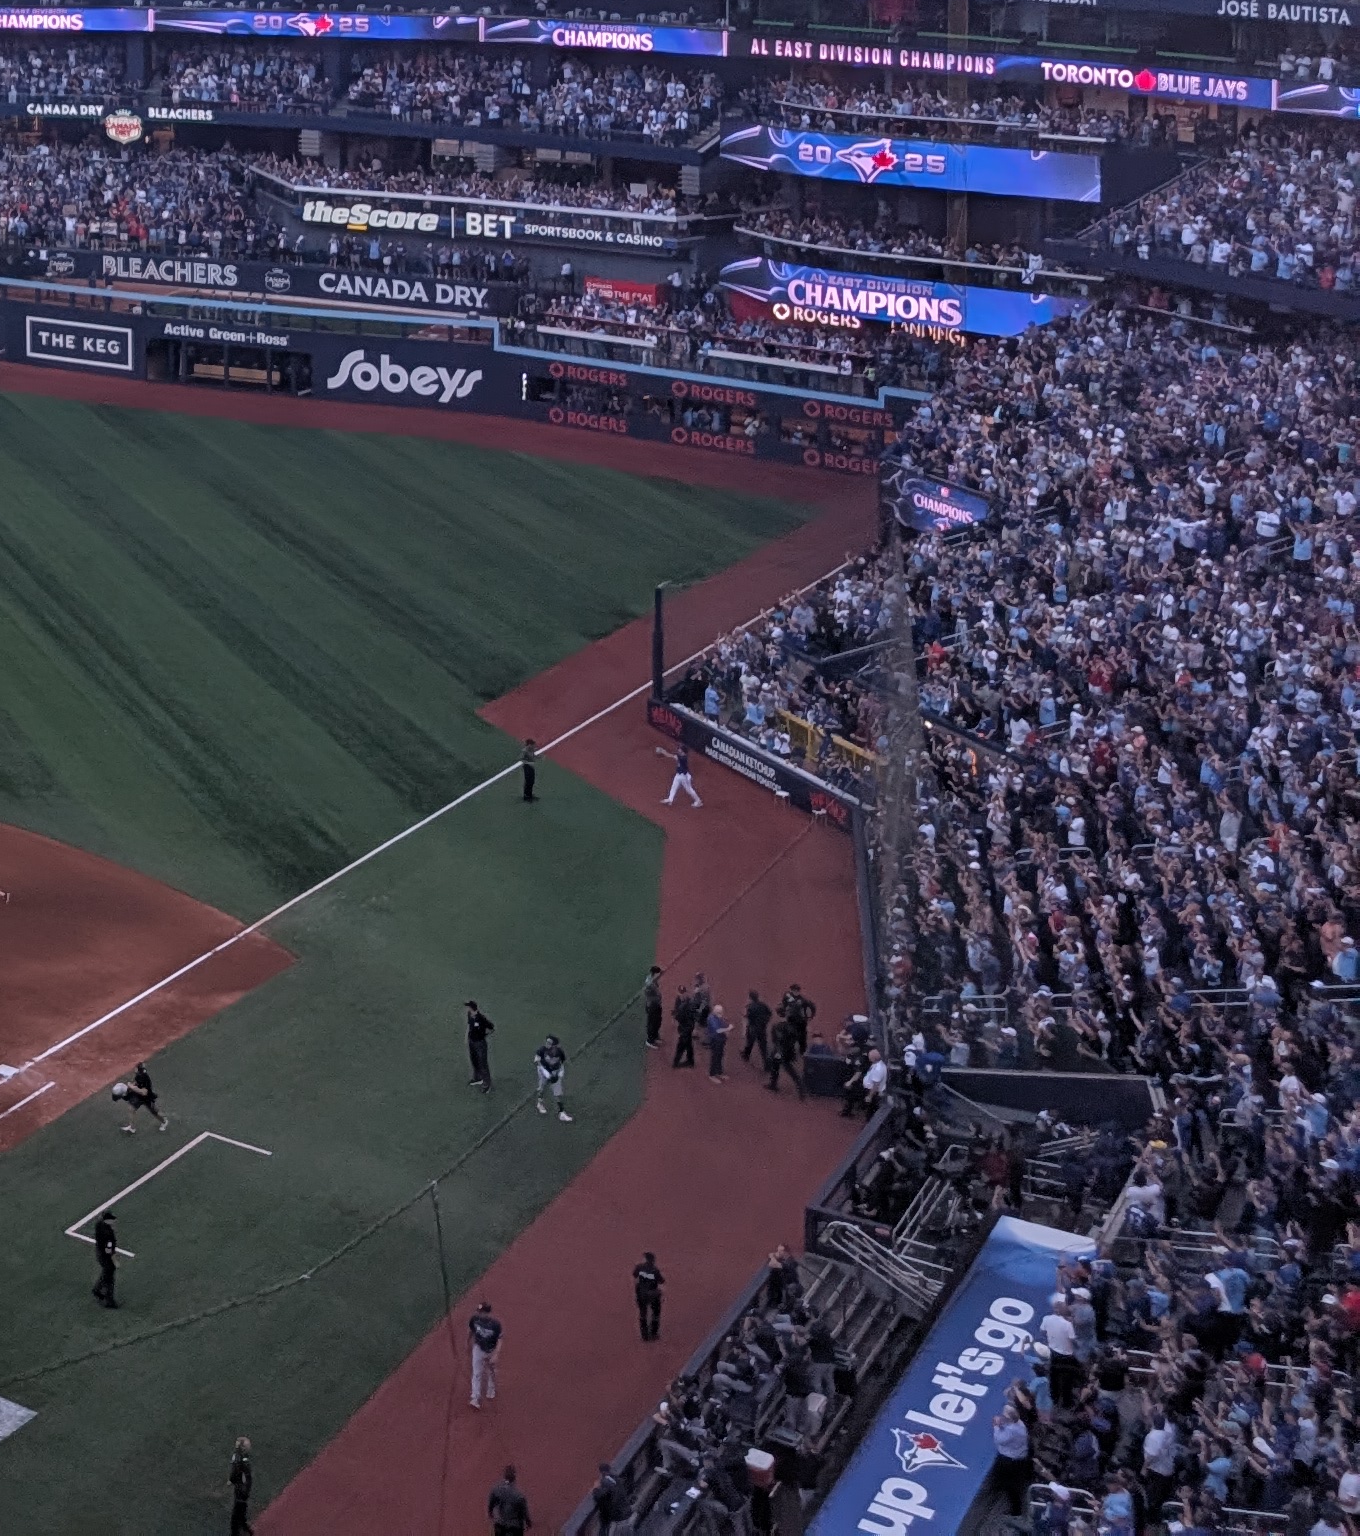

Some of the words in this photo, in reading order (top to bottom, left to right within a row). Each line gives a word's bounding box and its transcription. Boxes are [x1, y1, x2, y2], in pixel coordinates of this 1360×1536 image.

[1267, 4, 1352, 26] BAUTISTA
[552, 28, 654, 52] CHAMPIONS
[750, 37, 770, 56] AL
[774, 39, 812, 60] EAST
[819, 42, 892, 66] DIVISION
[899, 49, 996, 75] CHAMPIONS
[1041, 61, 1134, 89] TORONTO
[1157, 72, 1200, 97] BLUE
[1204, 78, 1250, 101] JAYS
[26, 103, 77, 116] CANADA
[80, 104, 105, 117] DRY
[148, 106, 213, 121] BLEACHERS
[798, 142, 831, 164] 20
[904, 153, 946, 174] 25
[302, 200, 440, 232] theScore
[465, 211, 517, 240] BET
[524, 223, 603, 242] SPORTSBOOK
[616, 231, 663, 248] CASINO
[102, 255, 239, 287] BLEACHERS
[318, 272, 430, 303] CANADA
[434, 283, 489, 309] DRY
[787, 279, 963, 327] CHAMPIONS
[793, 305, 861, 330] ROGERS
[38, 330, 75, 350] THE
[83, 336, 122, 356] KEG
[164, 322, 205, 339] Active
[208, 327, 288, 347] Green+Ross
[327, 349, 482, 403] Sobeys
[567, 365, 628, 386] ROGERS
[690, 383, 757, 407] ROGERS
[824, 403, 894, 429] ROGERS
[567, 411, 628, 434] ROGERS
[690, 430, 756, 455] ROGERS
[913, 492, 974, 524] CHAMPIONS
[974, 1297, 1035, 1353] go
[905, 1347, 1005, 1436] let's
[857, 1477, 936, 1536] up
